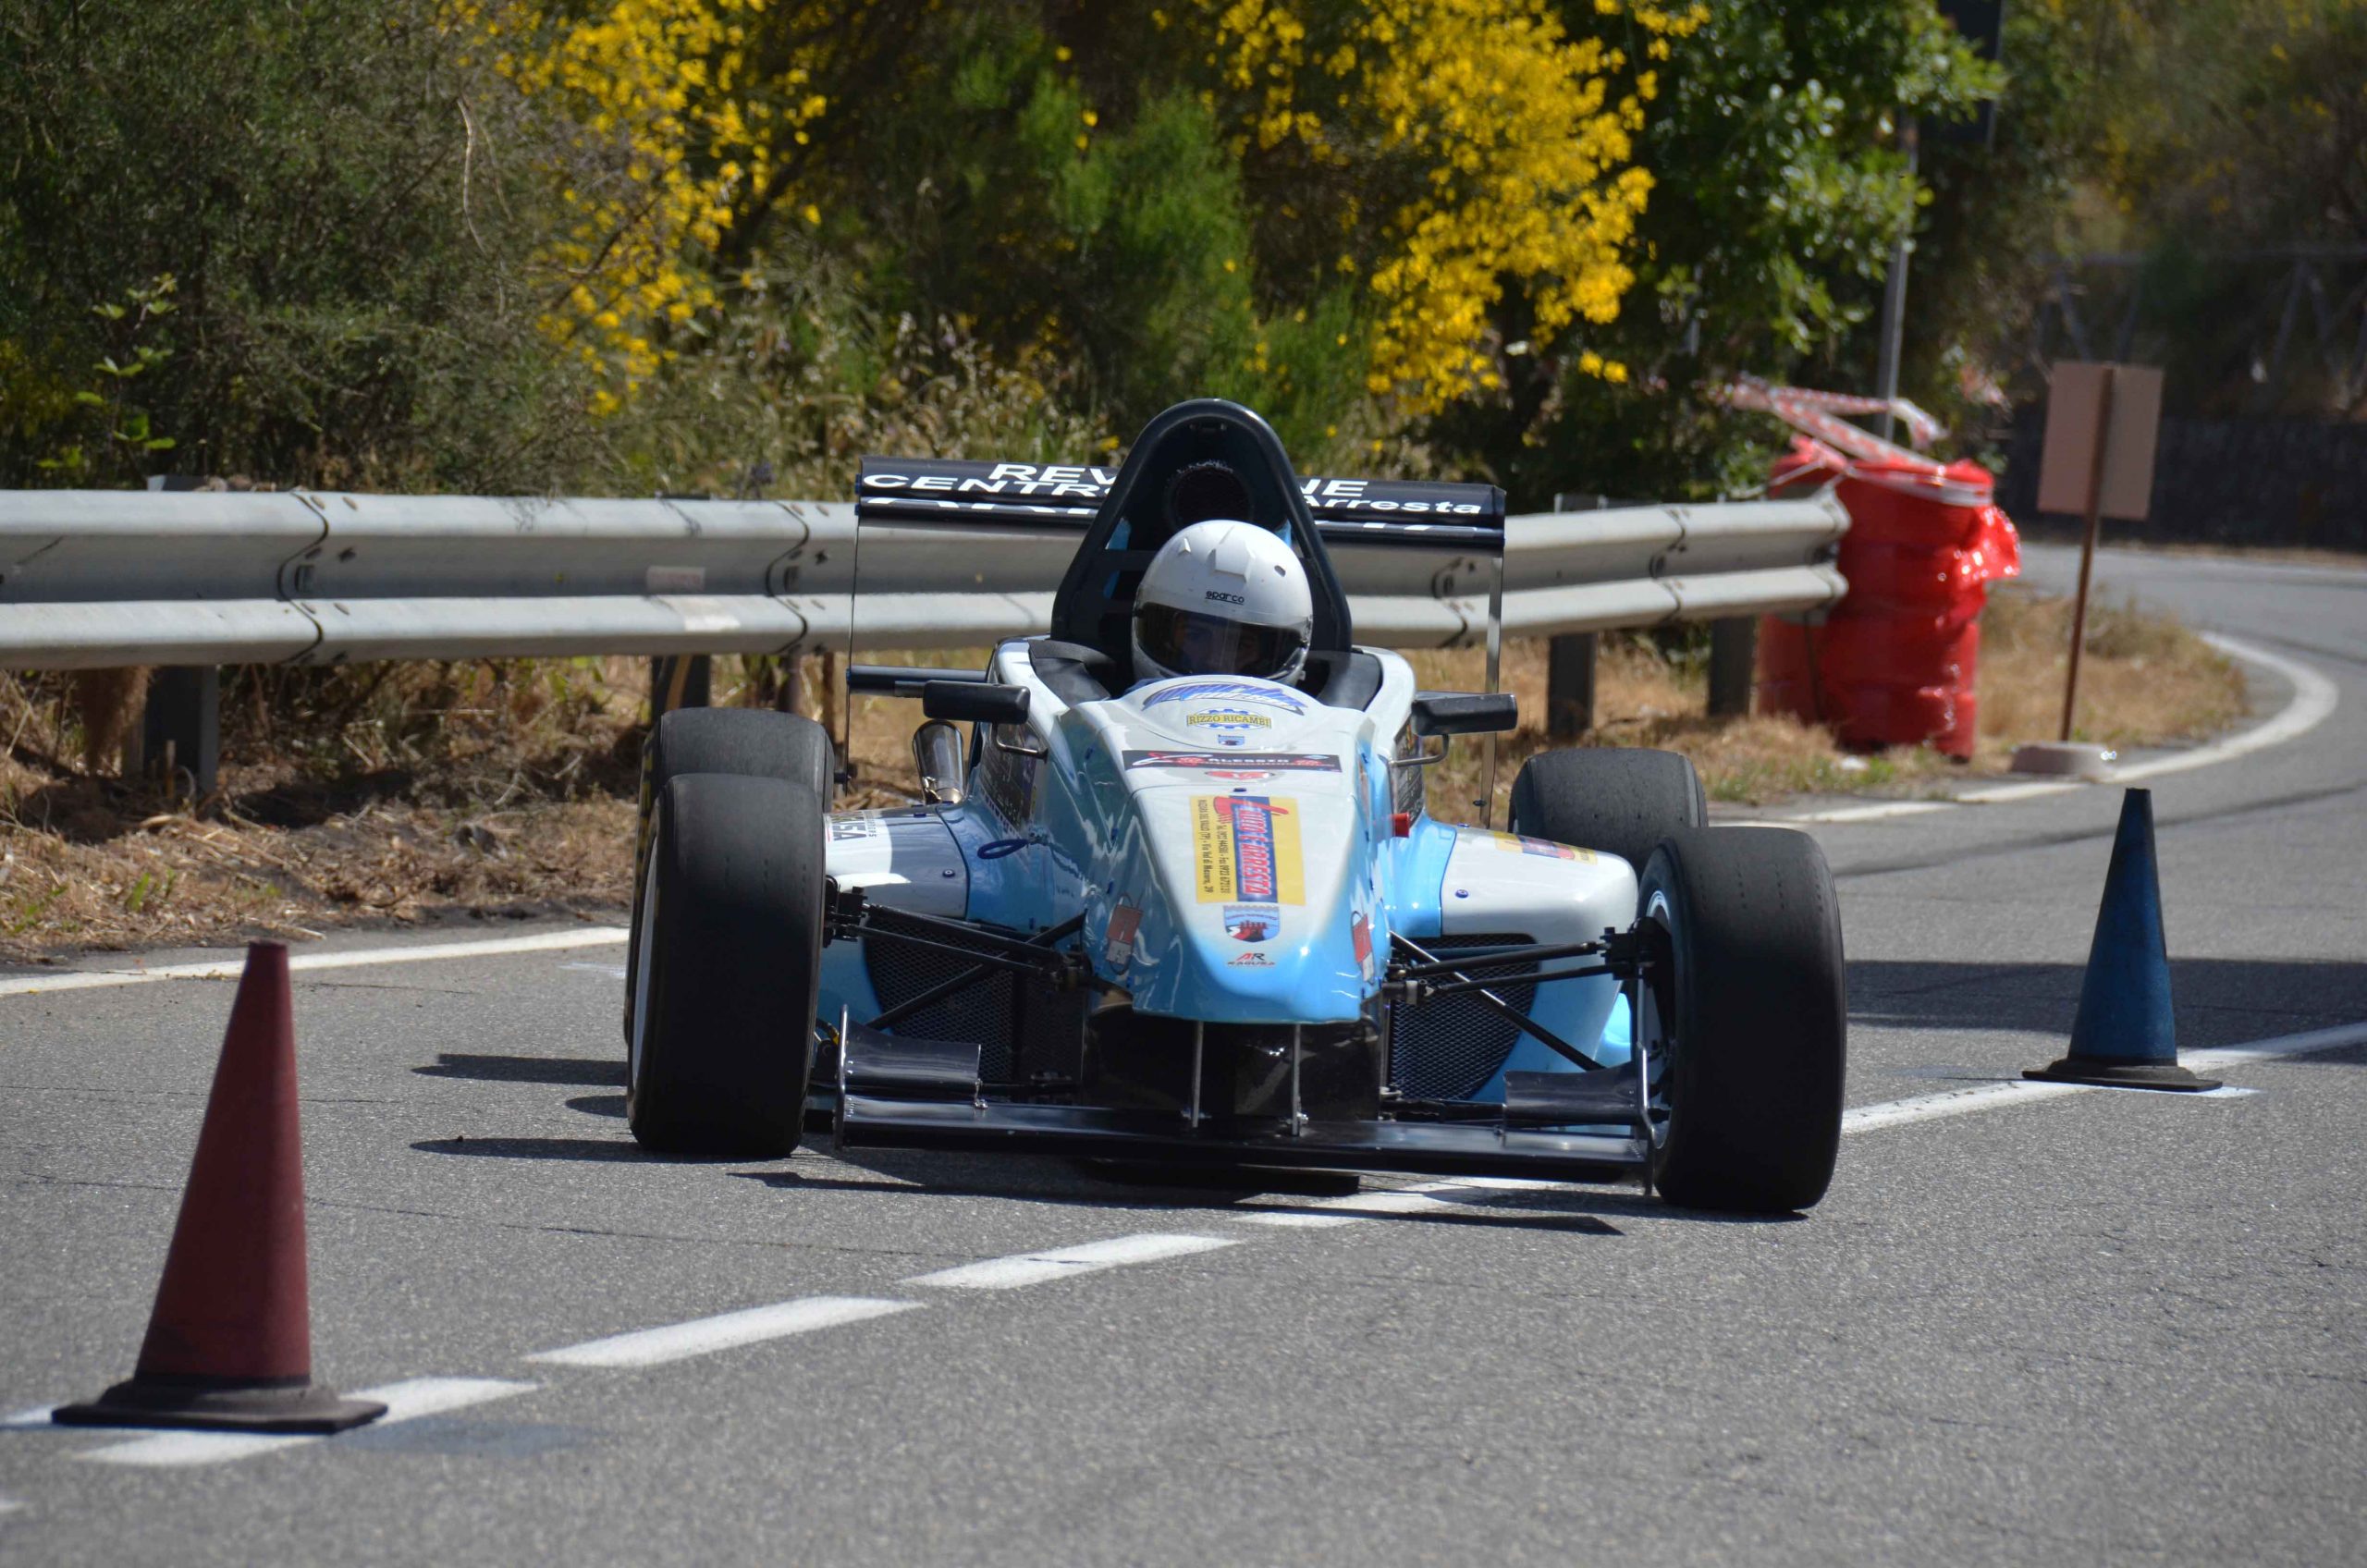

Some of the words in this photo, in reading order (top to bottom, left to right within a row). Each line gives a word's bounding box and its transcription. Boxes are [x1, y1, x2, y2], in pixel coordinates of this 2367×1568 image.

[863, 474, 1112, 497] CENTR
[1205, 591, 1245, 604] sparco
[1189, 715, 1220, 726] RIZZO
[1223, 715, 1269, 727] RICAMBI
[1241, 843, 1271, 895] ARRESTA
